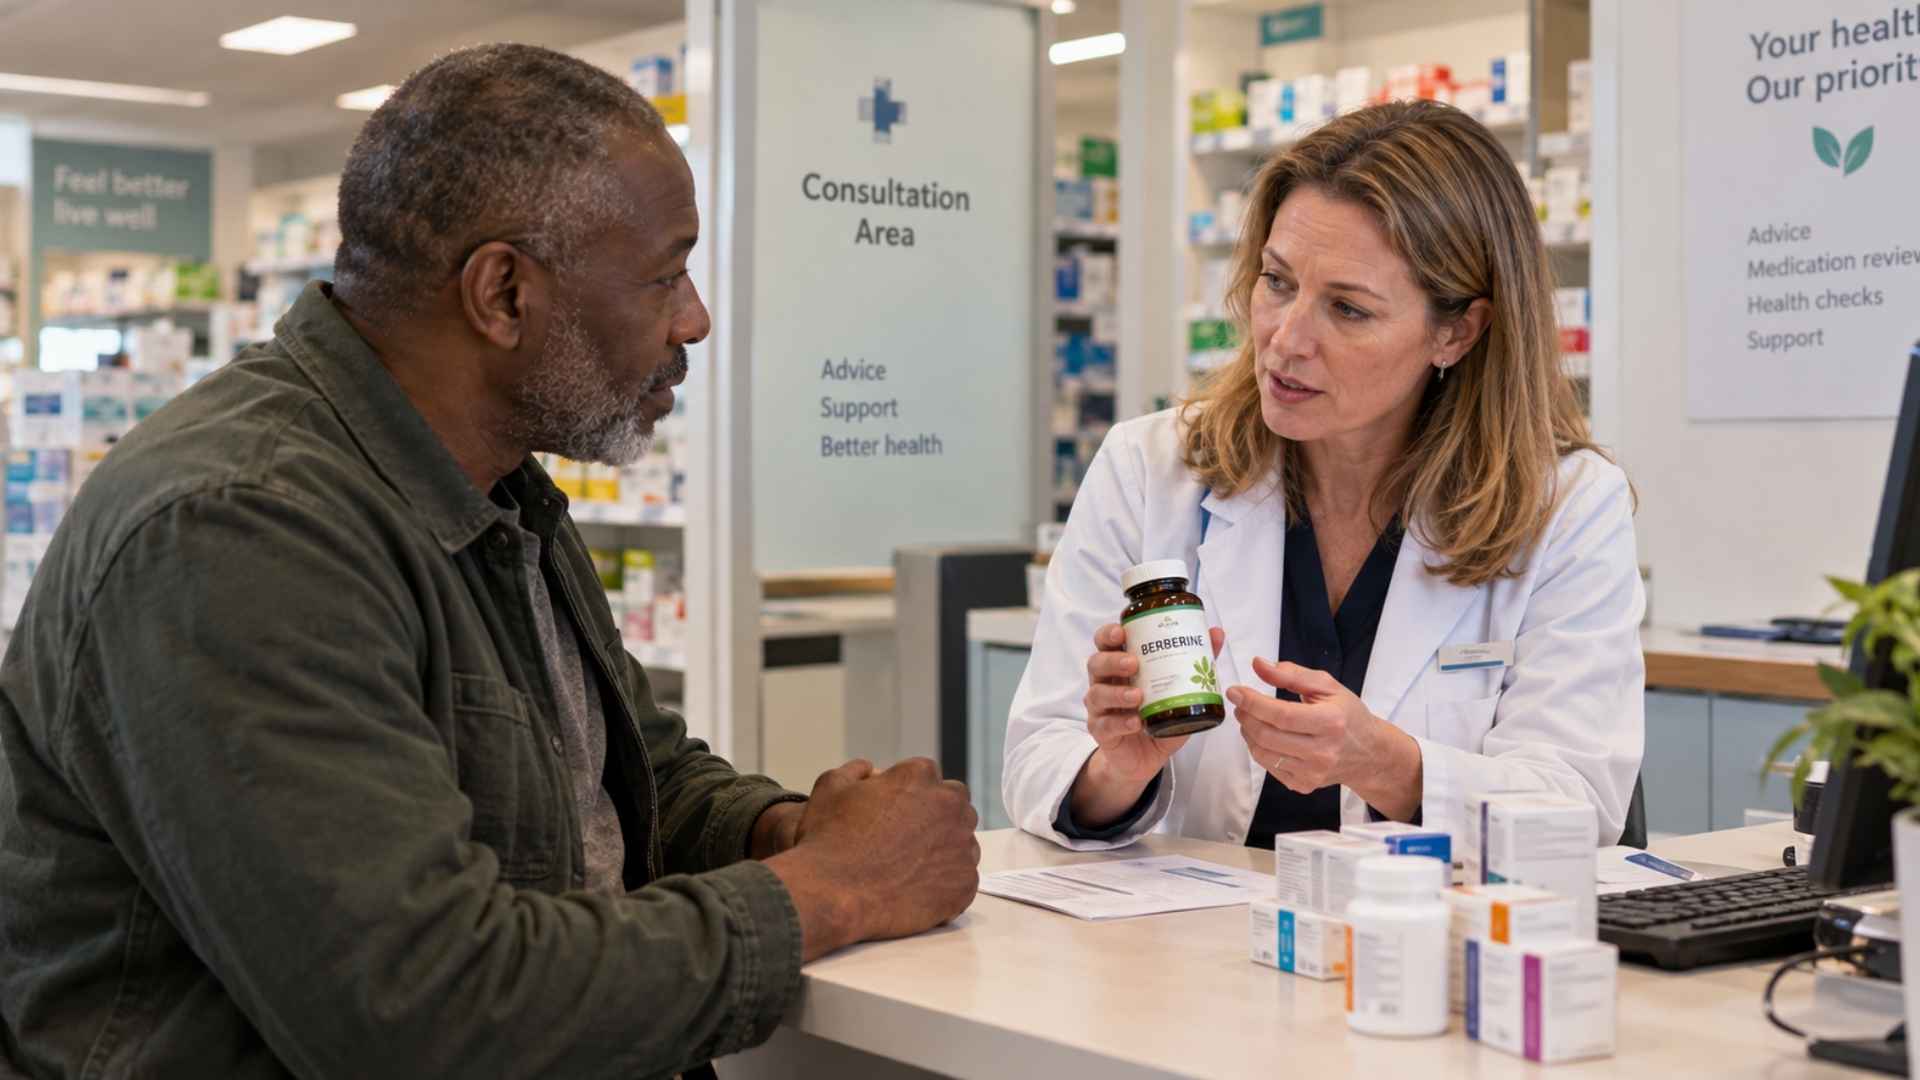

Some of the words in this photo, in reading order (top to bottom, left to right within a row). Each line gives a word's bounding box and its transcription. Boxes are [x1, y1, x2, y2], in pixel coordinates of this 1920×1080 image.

[1749, 30, 1820, 61] Your
[1746, 75, 1804, 104] Our
[1815, 52, 1920, 103] priorit
[53, 165, 108, 194] Feel
[112, 168, 190, 200] better
[802, 172, 970, 212] Consultation
[855, 217, 915, 247] Area
[1748, 223, 1811, 245] Advice
[1747, 253, 1856, 279] Medication
[1747, 291, 1809, 315] Health
[1815, 285, 1884, 311] checks
[1747, 328, 1824, 352] Support
[821, 357, 887, 381] Advice
[821, 396, 898, 423] Support
[821, 435, 879, 457] Better
[884, 433, 943, 456] health
[1140, 634, 1204, 656] BERBERINE
